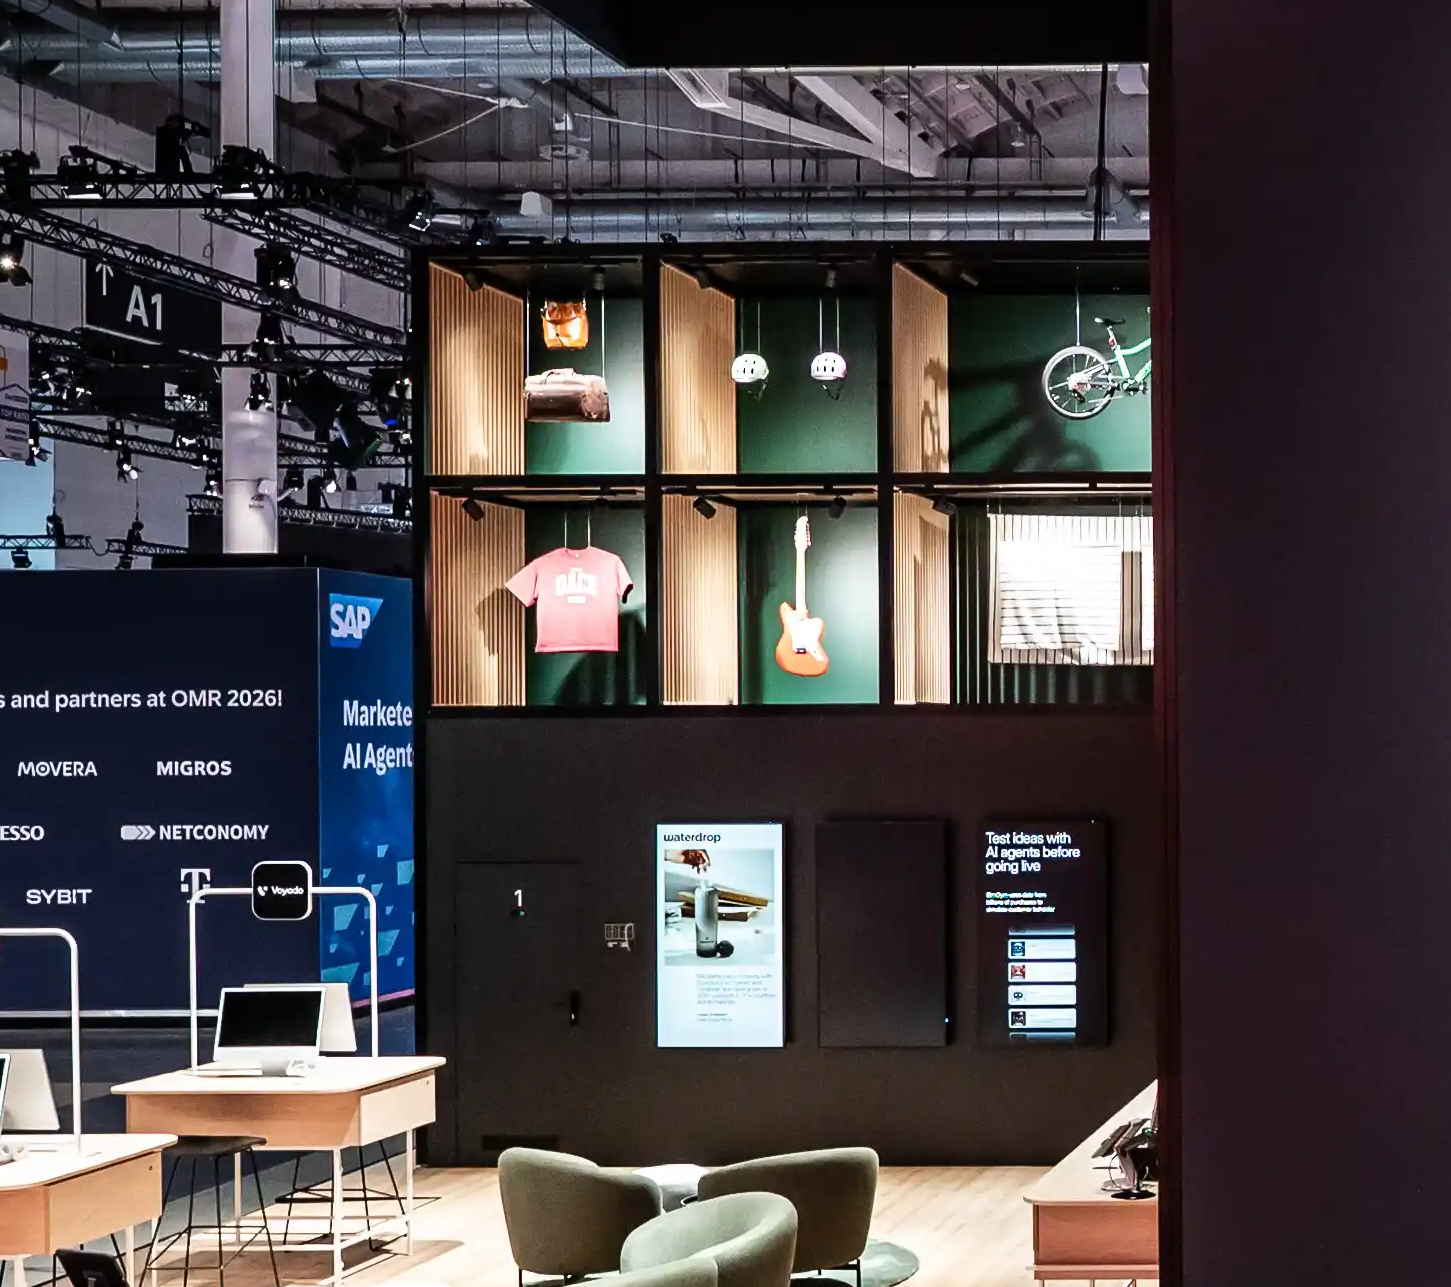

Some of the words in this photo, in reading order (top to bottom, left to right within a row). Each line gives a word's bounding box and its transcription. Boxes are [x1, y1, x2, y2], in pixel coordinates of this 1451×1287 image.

[126, 285, 163, 331] A1
[331, 603, 371, 639] SAP
[10, 690, 50, 708] and
[55, 691, 142, 712] partners
[147, 691, 166, 708] at
[171, 690, 222, 707] OMR
[226, 689, 283, 707] 2026!
[343, 742, 361, 769] AI
[364, 742, 414, 776] Agent
[17, 761, 98, 777] MOVERA
[156, 760, 232, 776] MIGROS
[159, 825, 269, 841] NETCONOMY
[663, 833, 721, 844] waterdrop
[985, 832, 1010, 844] Test
[1013, 832, 1044, 844] ideas
[1046, 832, 1072, 844] with
[985, 846, 998, 858] AI
[1000, 847, 1041, 860] agents
[1043, 845, 1081, 858] before
[985, 860, 1019, 874] going
[1021, 860, 1041, 871] live
[26, 888, 92, 905] SYBIT
[271, 885, 305, 897] Voyado
